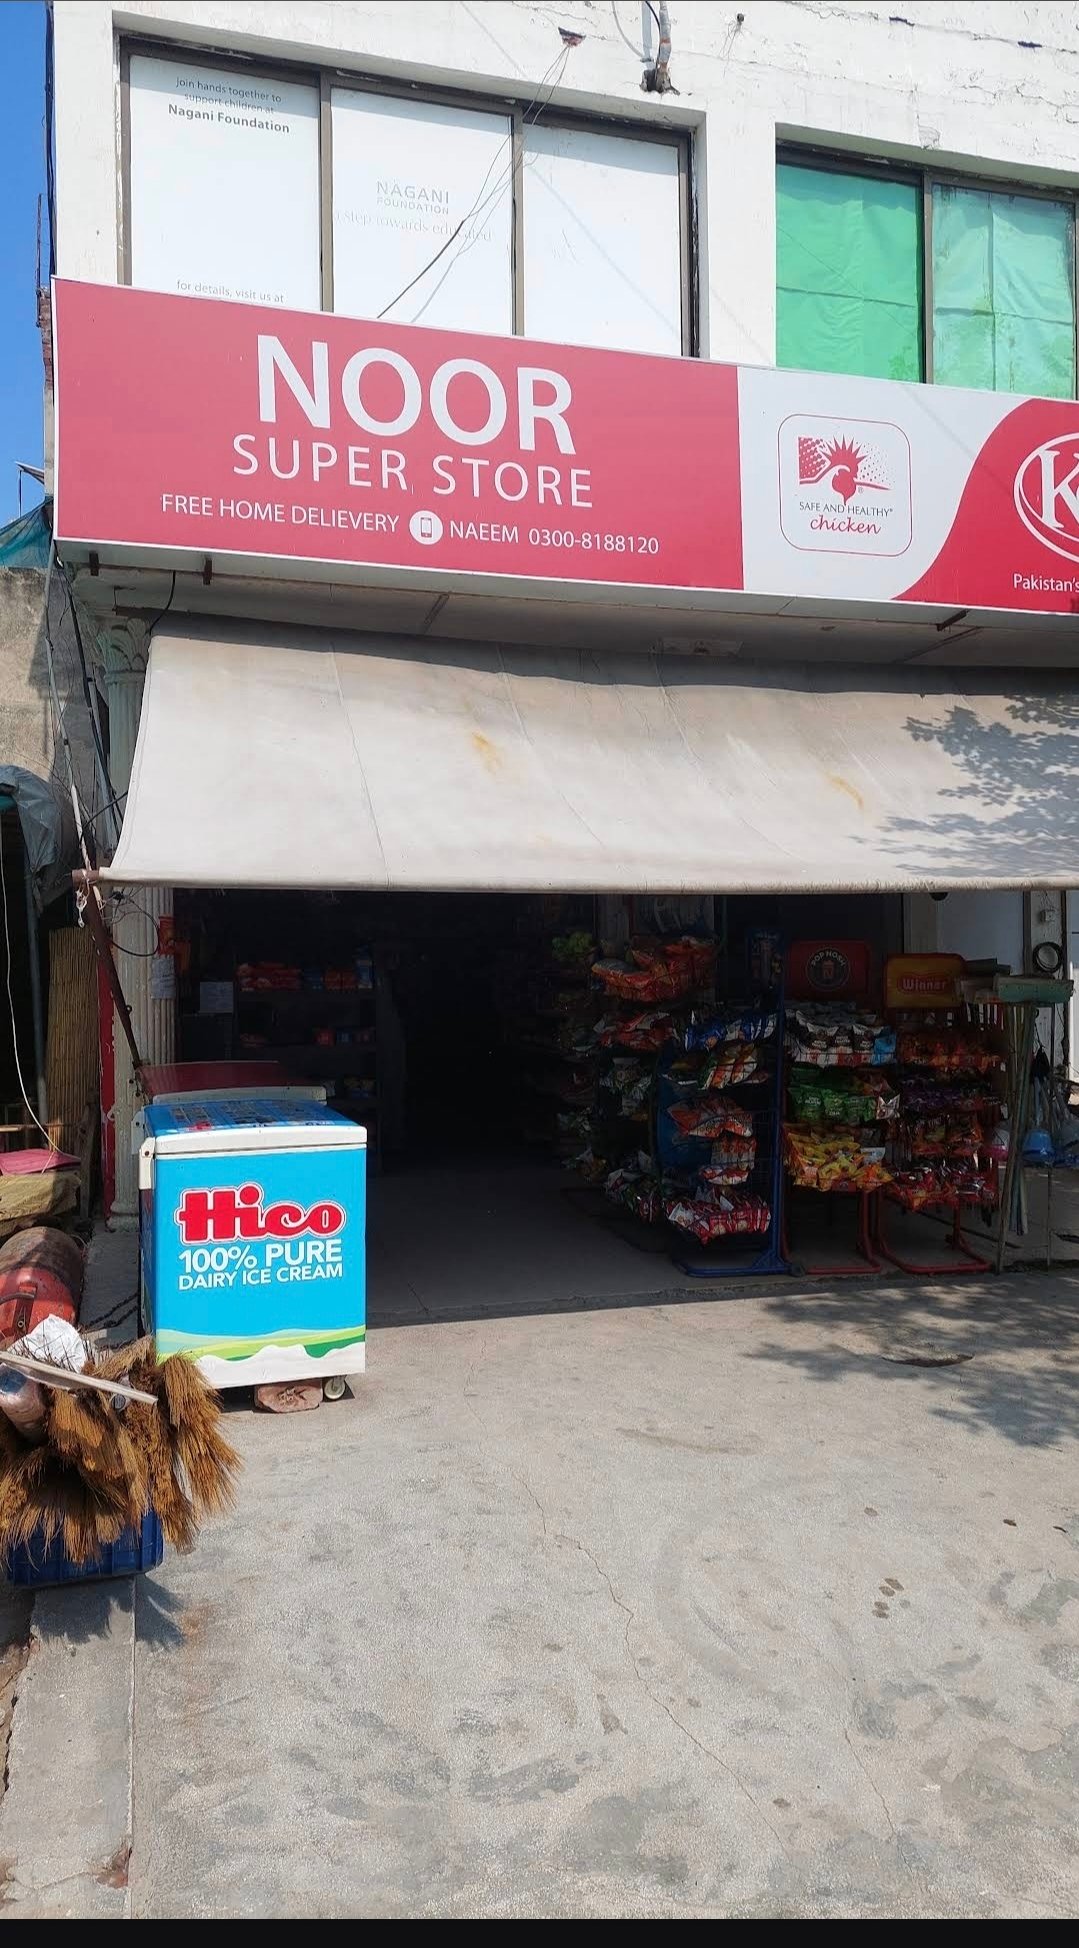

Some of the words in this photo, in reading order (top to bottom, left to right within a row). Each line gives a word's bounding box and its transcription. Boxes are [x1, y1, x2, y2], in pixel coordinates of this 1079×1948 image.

[175, 76, 195, 89] Join
[197, 81, 226, 94] hands
[229, 86, 269, 101] together
[271, 92, 282, 103] to
[184, 92, 222, 106] support
[224, 98, 263, 112] children
[265, 105, 274, 115] at
[168, 103, 214, 122] Nagani
[217, 112, 290, 133] Foundation
[376, 181, 449, 204] NAGANI
[376, 197, 449, 215] FOUNDATION
[376, 214, 429, 232] towards
[176, 279, 192, 291] for
[194, 282, 233, 298] details,
[235, 288, 257, 299] visit
[259, 292, 271, 302] us
[274, 293, 284, 303] at
[257, 334, 577, 455] NOOR
[233, 433, 409, 492] SUPER
[432, 454, 594, 508] STORE
[1037, 449, 1079, 529] K
[799, 501, 821, 512] SAFE
[823, 503, 845, 513] AND
[161, 493, 214, 517] FREE
[219, 498, 286, 524] HOME
[292, 504, 400, 534] DELIEVERY
[450, 519, 519, 545] NAEEM
[528, 527, 660, 555] 0300-8188120
[810, 514, 882, 535] chicken
[1013, 572, 1079, 594] Pakistan's
[903, 978, 947, 991] Winner
[175, 1183, 345, 1245] Hico
[178, 1244, 258, 1274] 100%
[266, 1239, 343, 1267] PURE
[178, 1271, 237, 1291] DAIRY
[242, 1267, 271, 1286] ICE
[277, 1263, 343, 1282] CREAM
